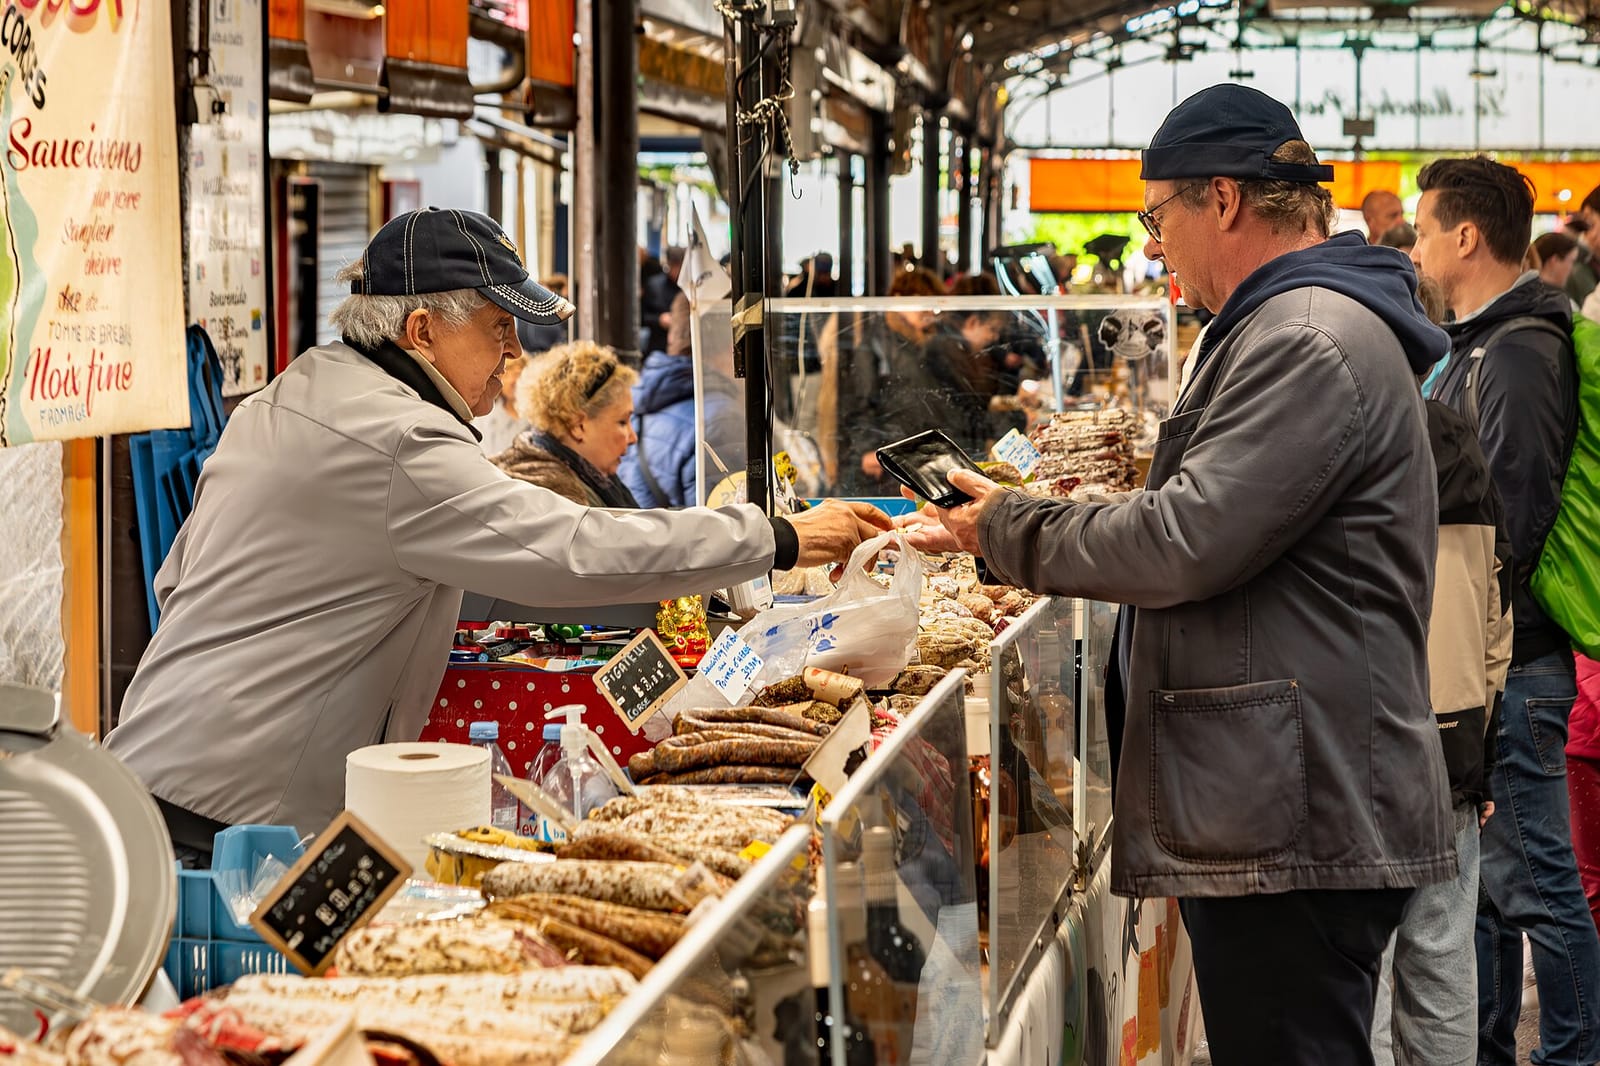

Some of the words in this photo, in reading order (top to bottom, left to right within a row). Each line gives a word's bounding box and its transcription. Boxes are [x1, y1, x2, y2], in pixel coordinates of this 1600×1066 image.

[39, 402, 87, 429] FROMAGE
[601, 643, 649, 692] FIGATELLI
[521, 823, 538, 836] ev
